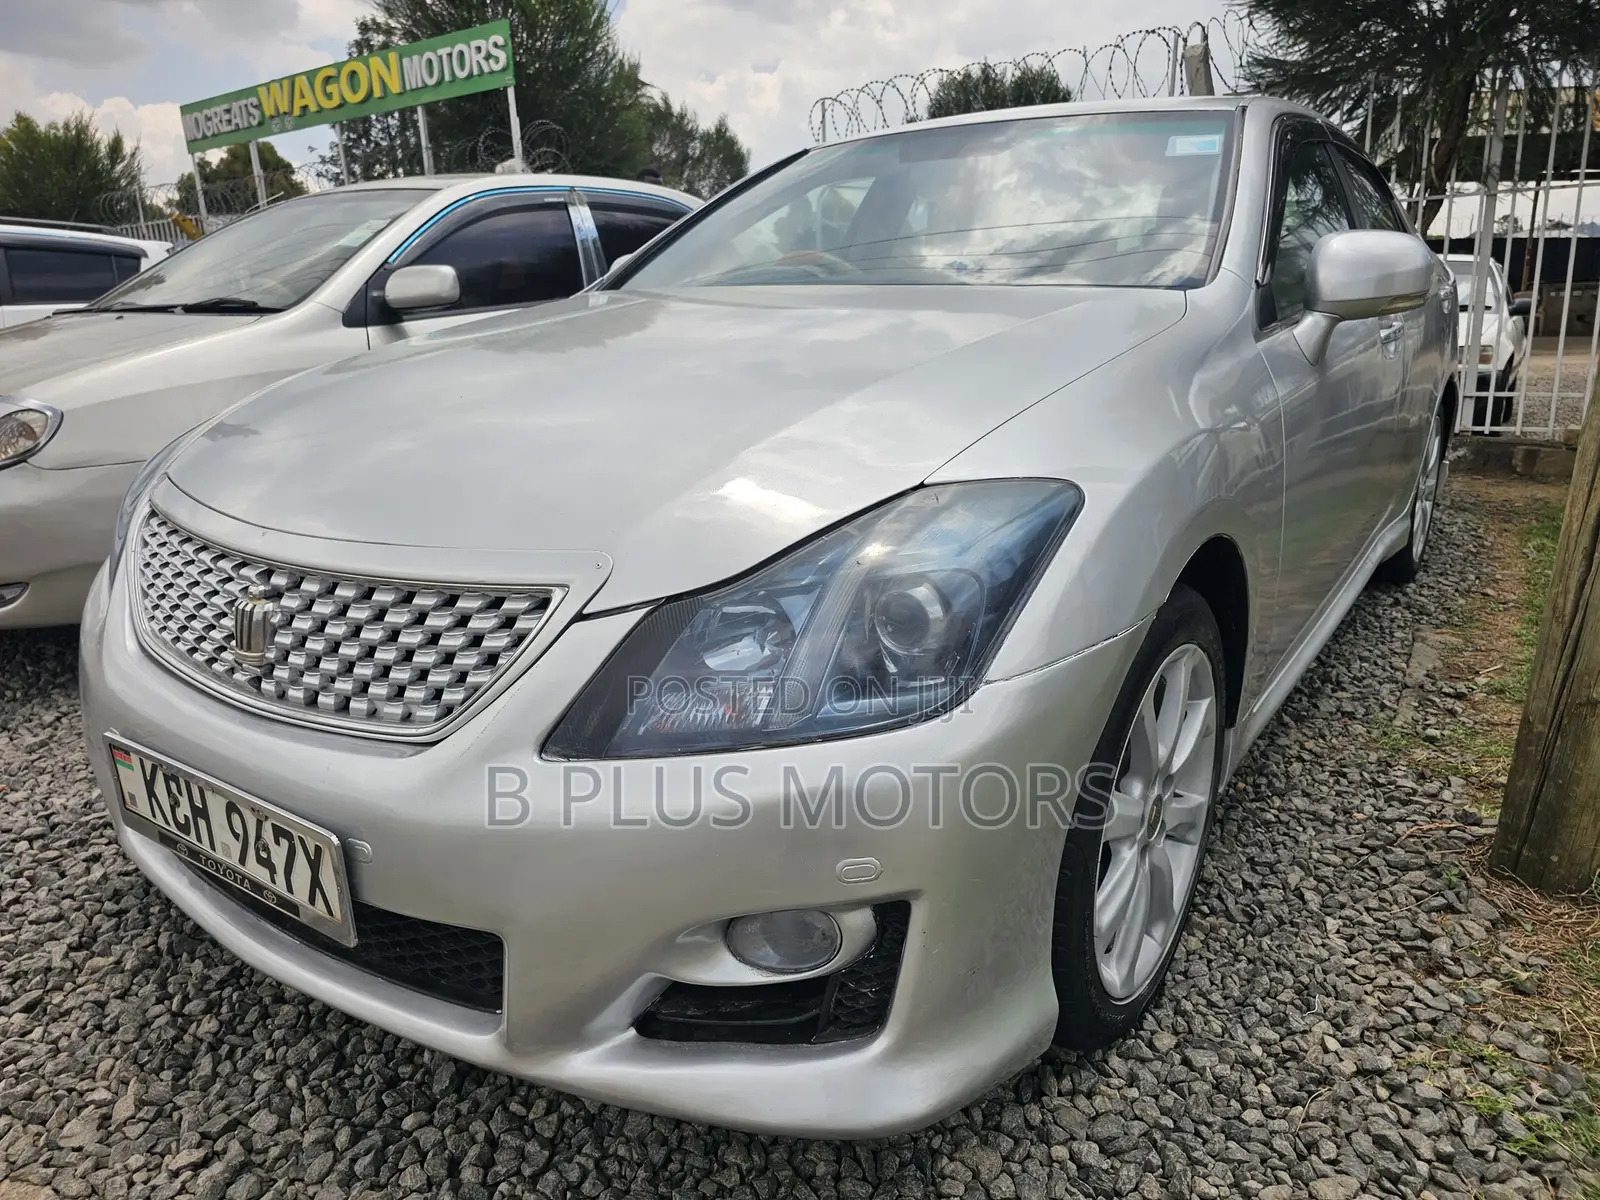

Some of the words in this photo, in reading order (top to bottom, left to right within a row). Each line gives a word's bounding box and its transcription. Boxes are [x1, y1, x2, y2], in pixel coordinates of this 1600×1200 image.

[257, 51, 403, 118] WAGON
[402, 35, 508, 91] MOTORS
[199, 854, 252, 891] TOYOTA
[225, 800, 335, 918] 947X
